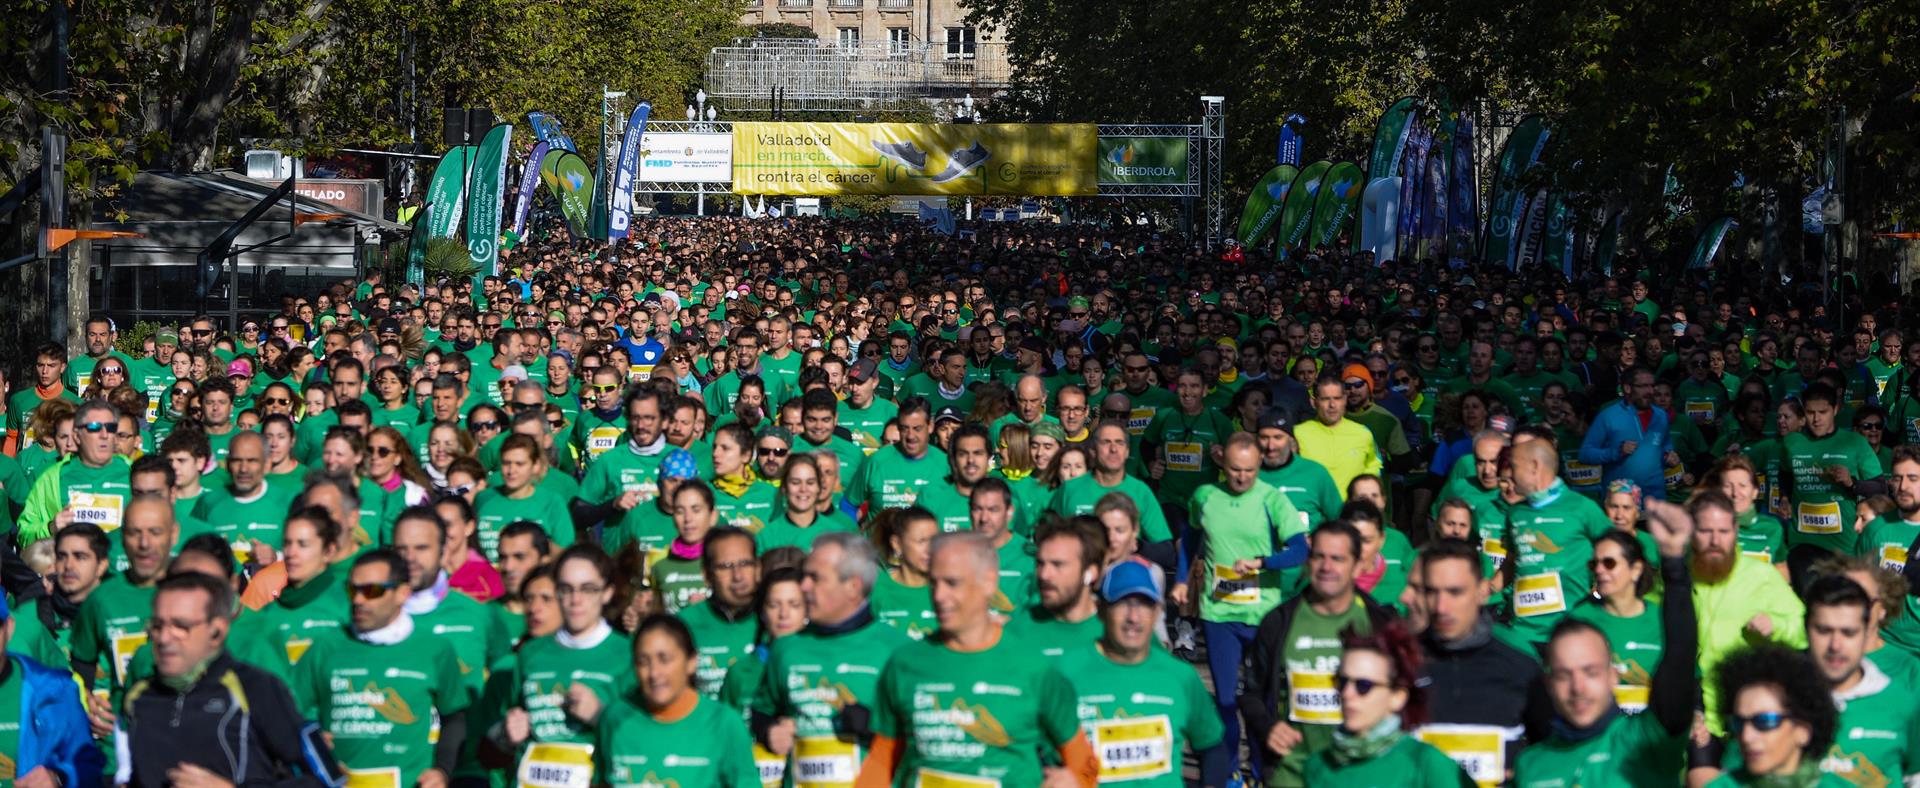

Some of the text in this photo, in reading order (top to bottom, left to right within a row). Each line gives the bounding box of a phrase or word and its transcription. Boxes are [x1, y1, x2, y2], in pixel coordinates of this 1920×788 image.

[757, 134, 831, 146] Valladolid
[757, 151, 775, 161] en
[1113, 166, 1176, 177] IBERDROLA
[757, 171, 876, 184] contra el cáncer
